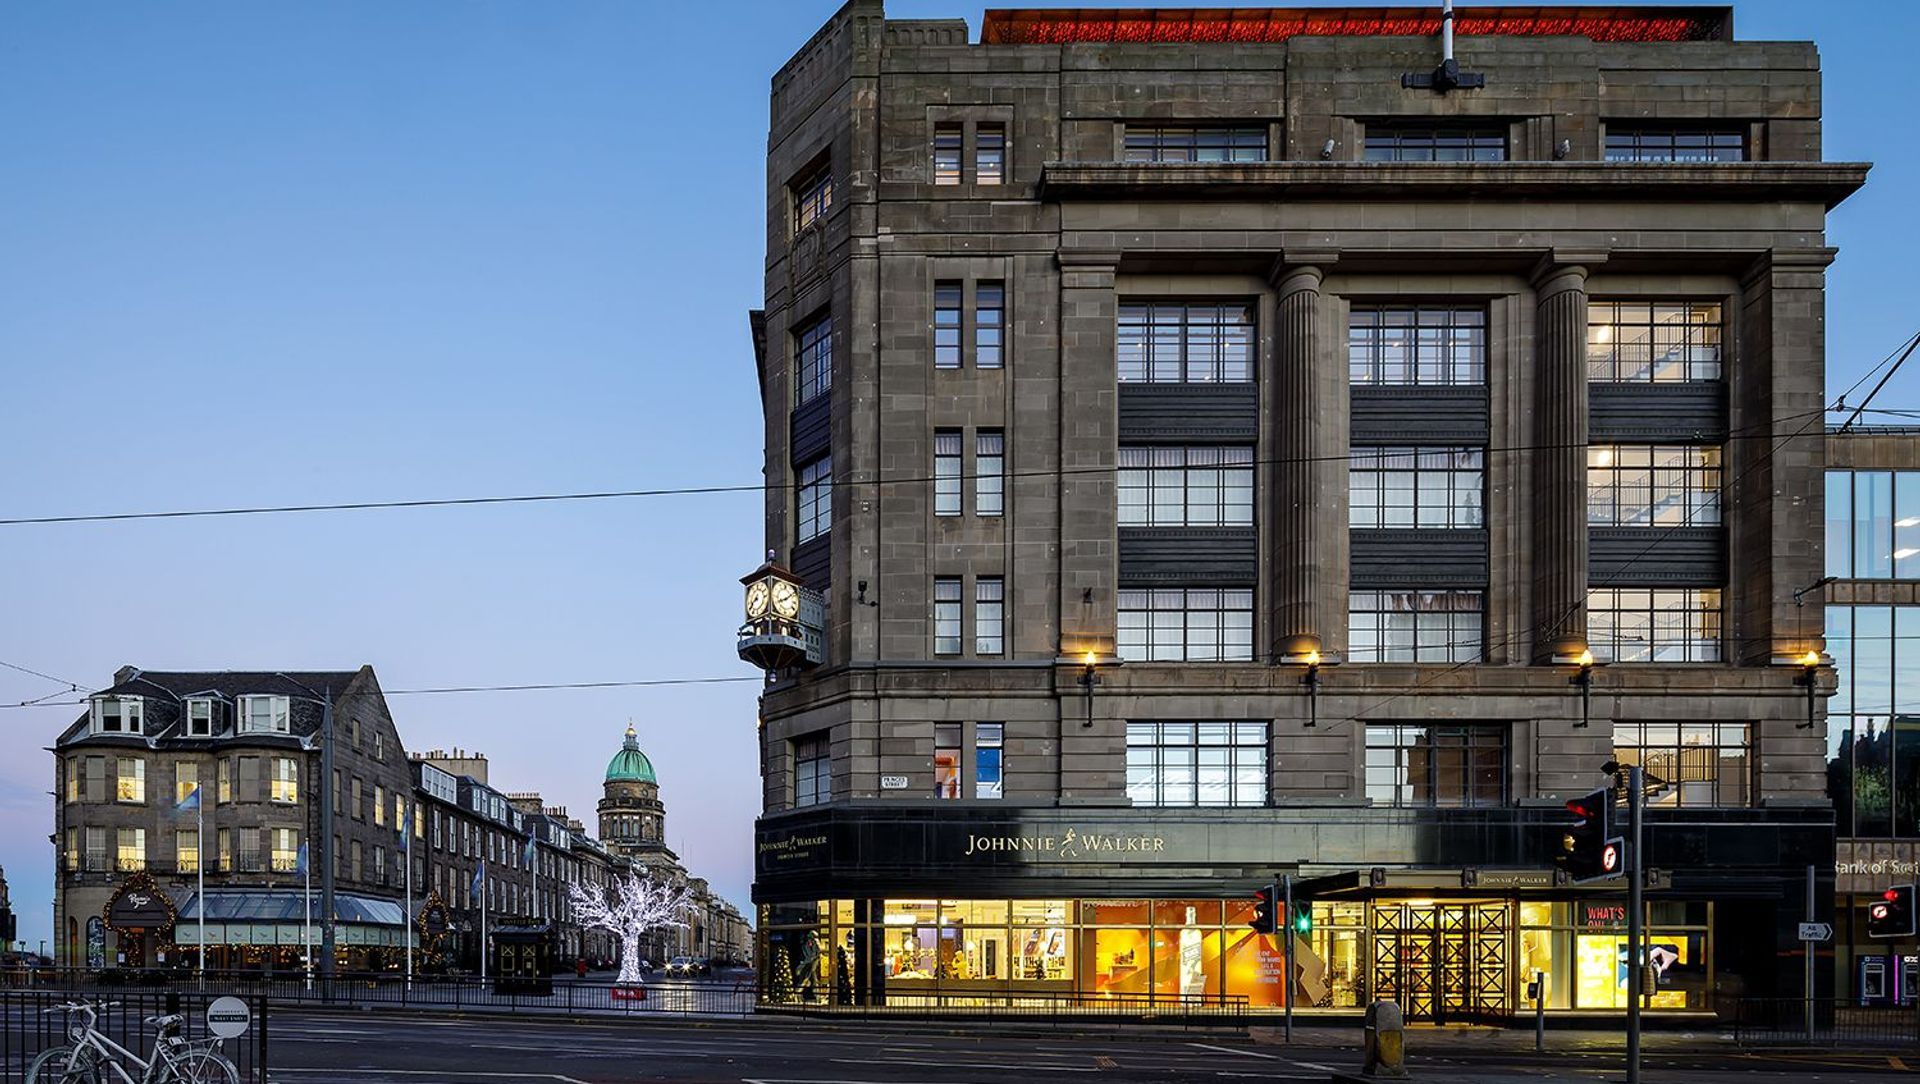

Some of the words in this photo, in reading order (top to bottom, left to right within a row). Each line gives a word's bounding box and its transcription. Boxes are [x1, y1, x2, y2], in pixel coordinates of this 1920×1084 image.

[759, 841, 789, 853] JOHNNIE
[796, 836, 827, 846] WALKER
[965, 835, 1055, 855] JOHNNIE
[1082, 835, 1165, 851] WALKER
[1871, 859, 1888, 874] of
[1587, 907, 1625, 920] WHAT'S
